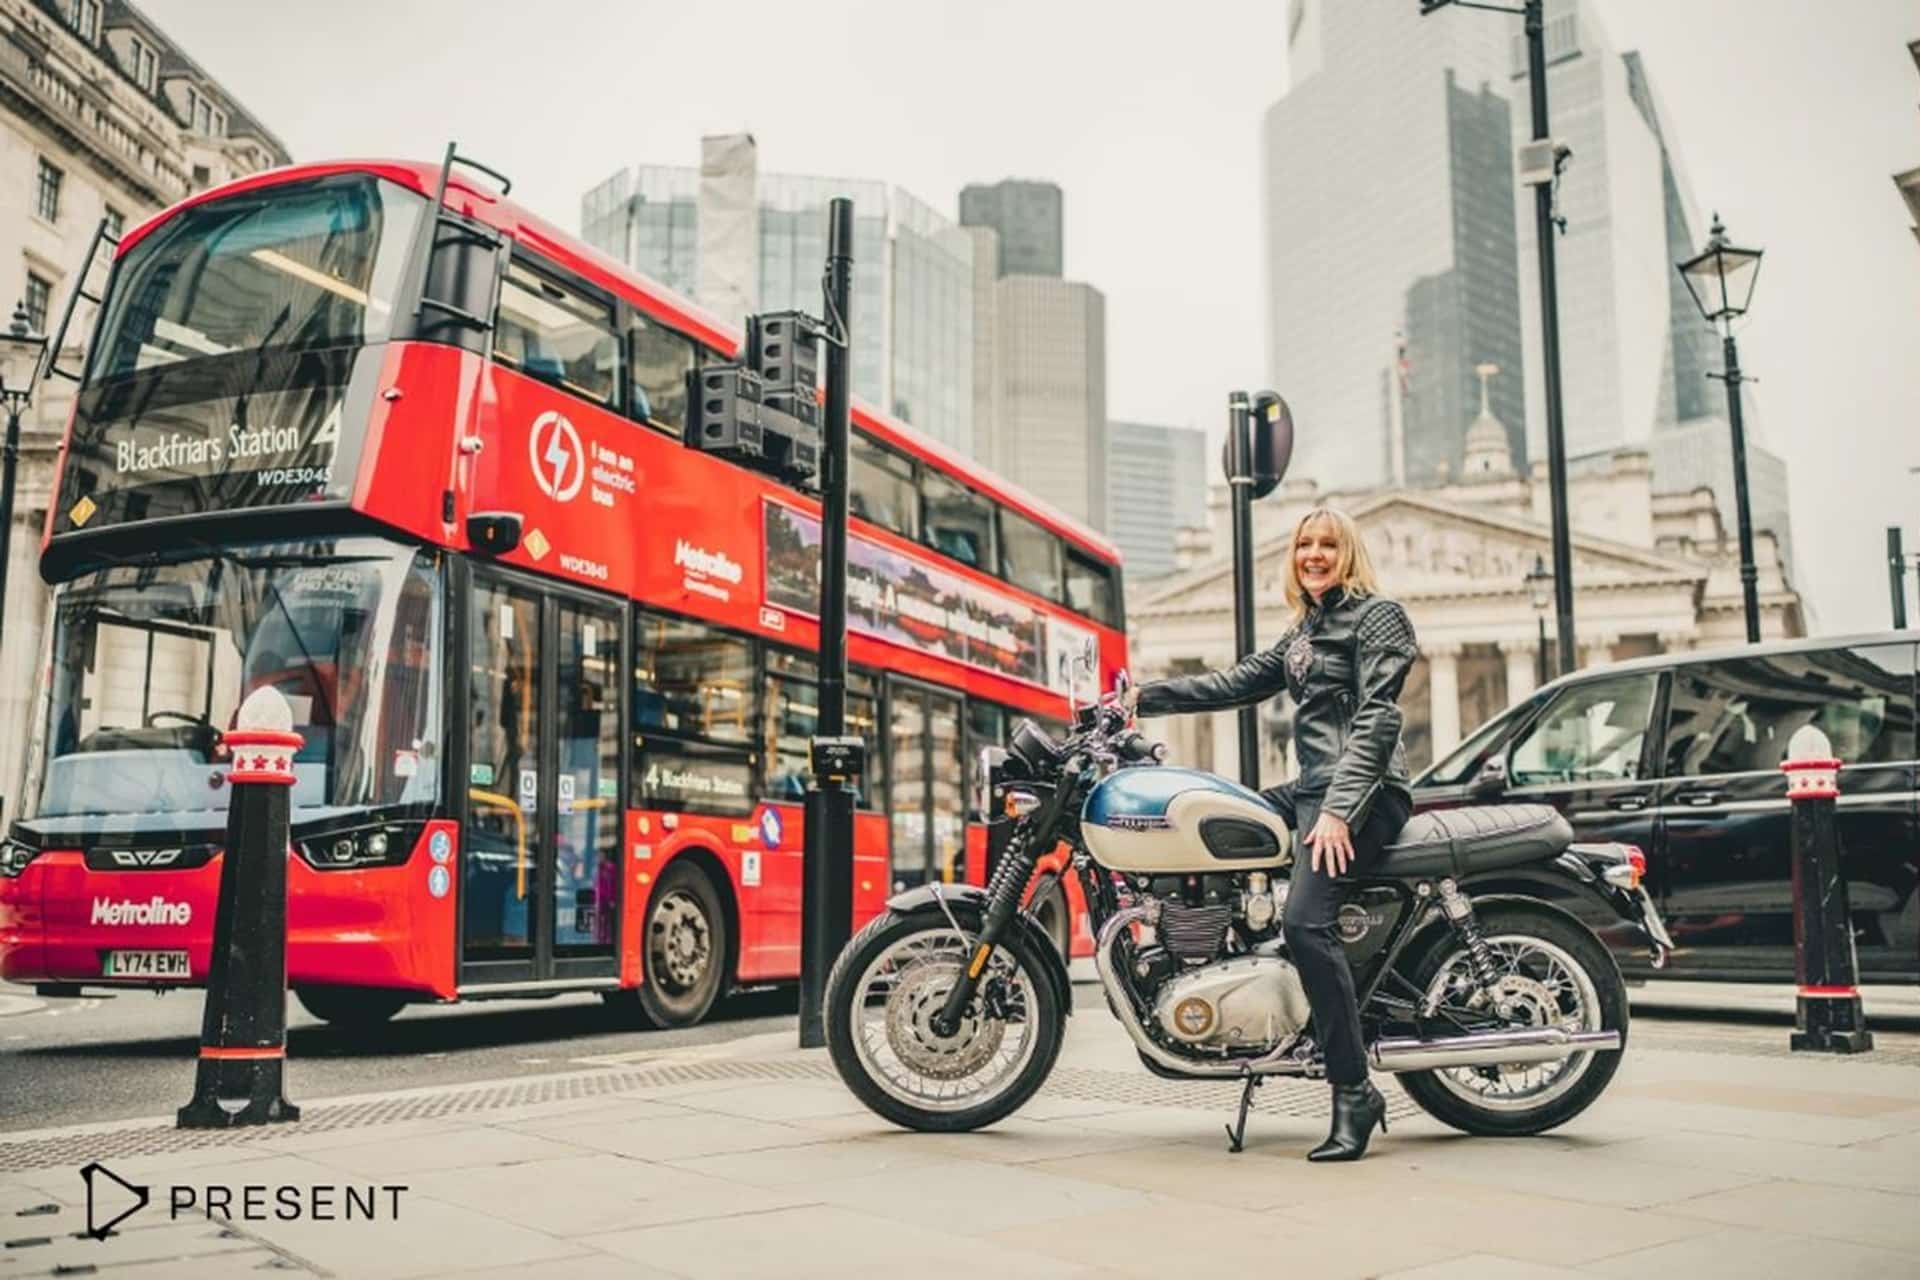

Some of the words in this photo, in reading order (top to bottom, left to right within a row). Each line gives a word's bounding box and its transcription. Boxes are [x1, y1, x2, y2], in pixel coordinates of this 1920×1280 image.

[117, 432, 222, 473] Blackfriars
[229, 424, 299, 459] Station
[312, 400, 342, 470] 4
[258, 468, 332, 485] WDE3045
[645, 763, 659, 790] 4
[90, 895, 192, 925] Metroline
[113, 953, 152, 973] LY74
